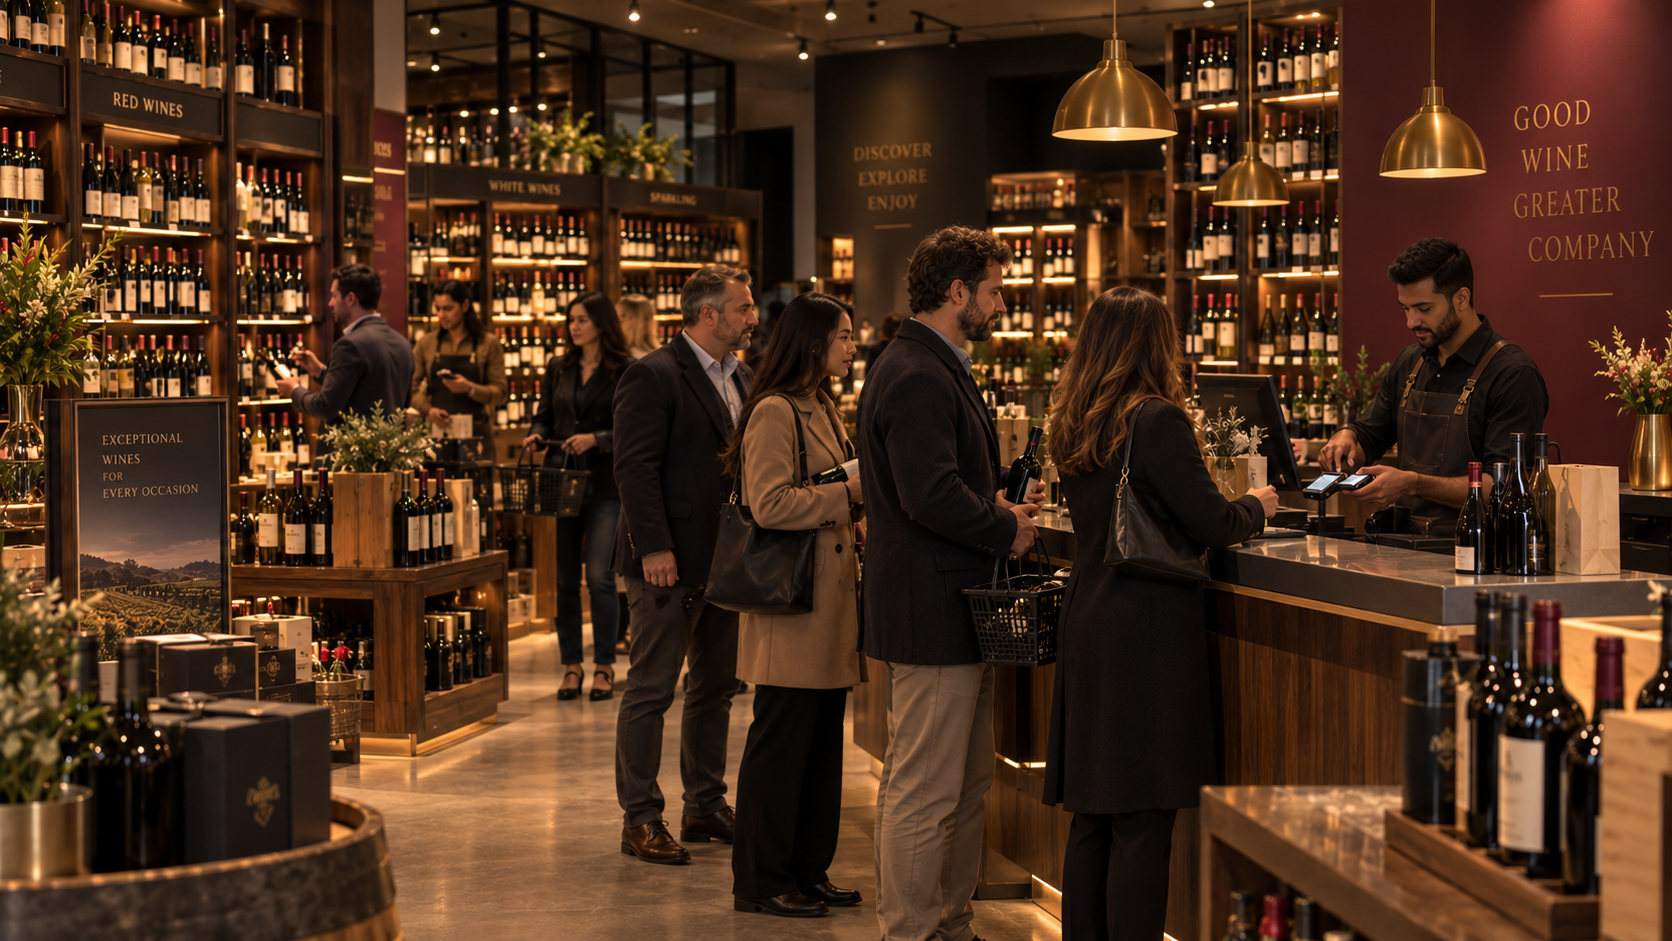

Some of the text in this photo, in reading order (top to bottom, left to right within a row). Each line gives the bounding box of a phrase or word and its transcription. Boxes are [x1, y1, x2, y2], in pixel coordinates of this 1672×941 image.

[113, 91, 183, 119] RED WINES
[1514, 99, 1591, 131] GOOD
[853, 142, 933, 162] DISCOVER
[1521, 143, 1590, 174] WINE
[858, 167, 928, 187] EXPLORE
[488, 179, 562, 196] WHITE WINES
[649, 191, 698, 206] SPARKLING
[867, 193, 919, 211] ENJOY
[1514, 186, 1622, 219] GREATER
[1528, 230, 1655, 263] COMPANY
[102, 432, 184, 446] EXCEPTIONAL
[102, 453, 141, 465] WINES
[102, 471, 123, 482] FOR
[103, 483, 199, 499] EVERY OCCASION
